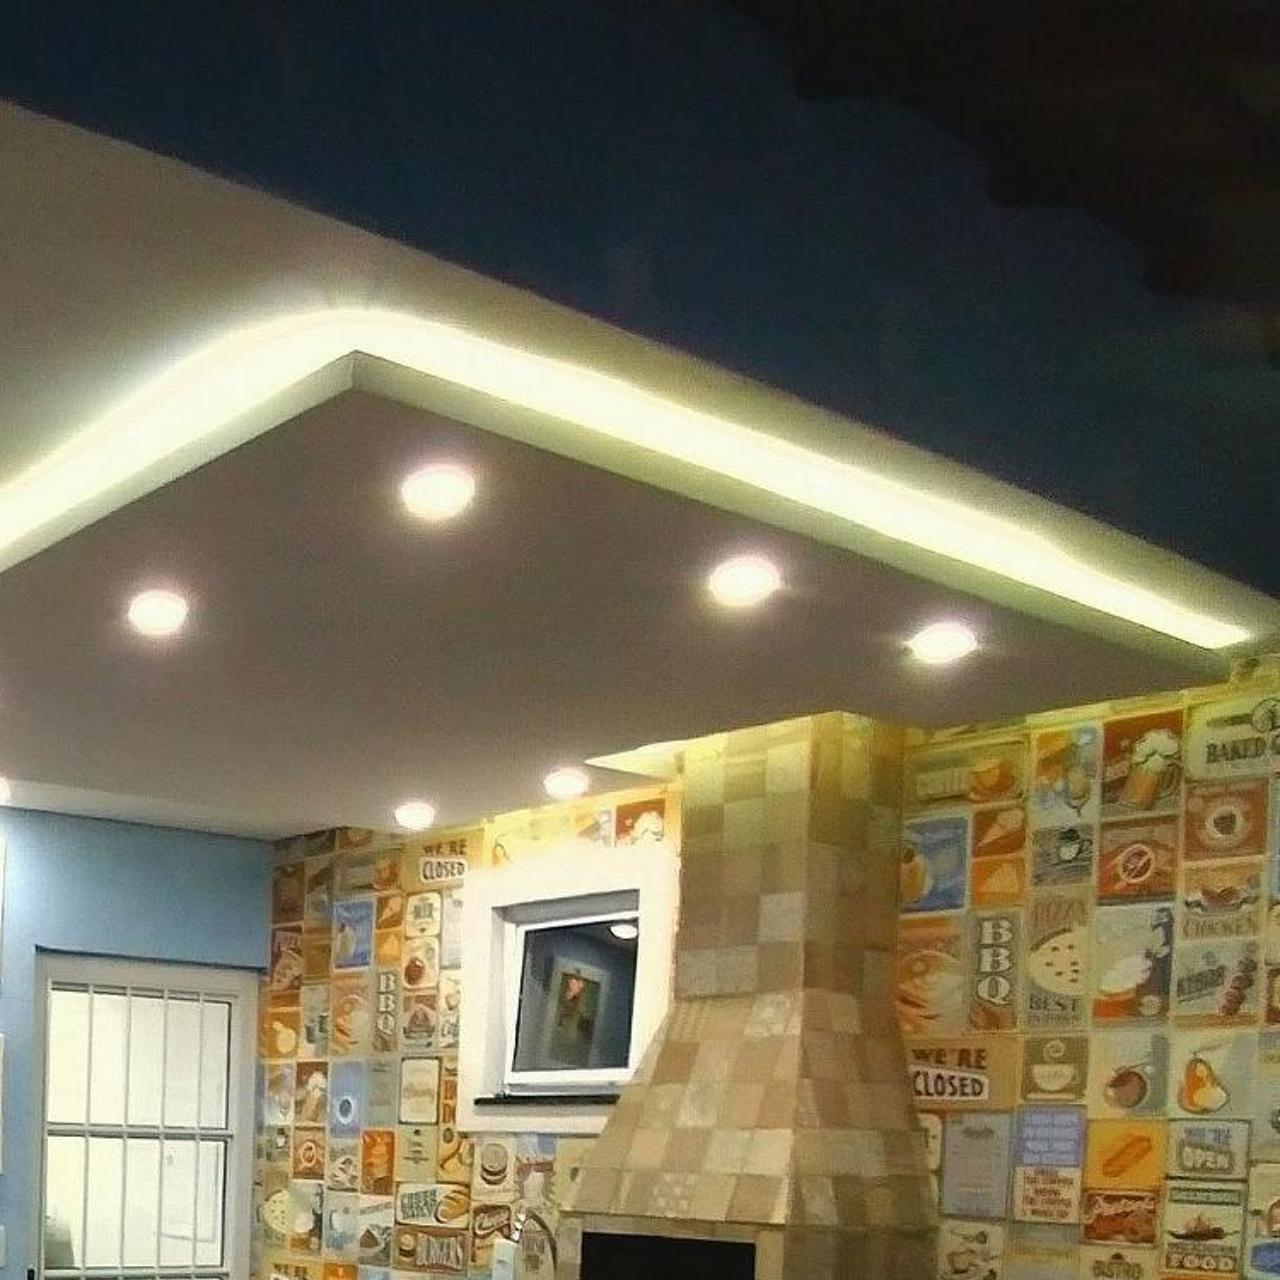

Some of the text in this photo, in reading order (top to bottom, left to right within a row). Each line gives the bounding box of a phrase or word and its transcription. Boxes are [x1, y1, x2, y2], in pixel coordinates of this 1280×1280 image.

[422, 861, 465, 880] CLOSED
[977, 917, 1015, 1006] BBQ
[913, 1070, 984, 1096] CLOSED
[1170, 1253, 1235, 1271] FOOD
